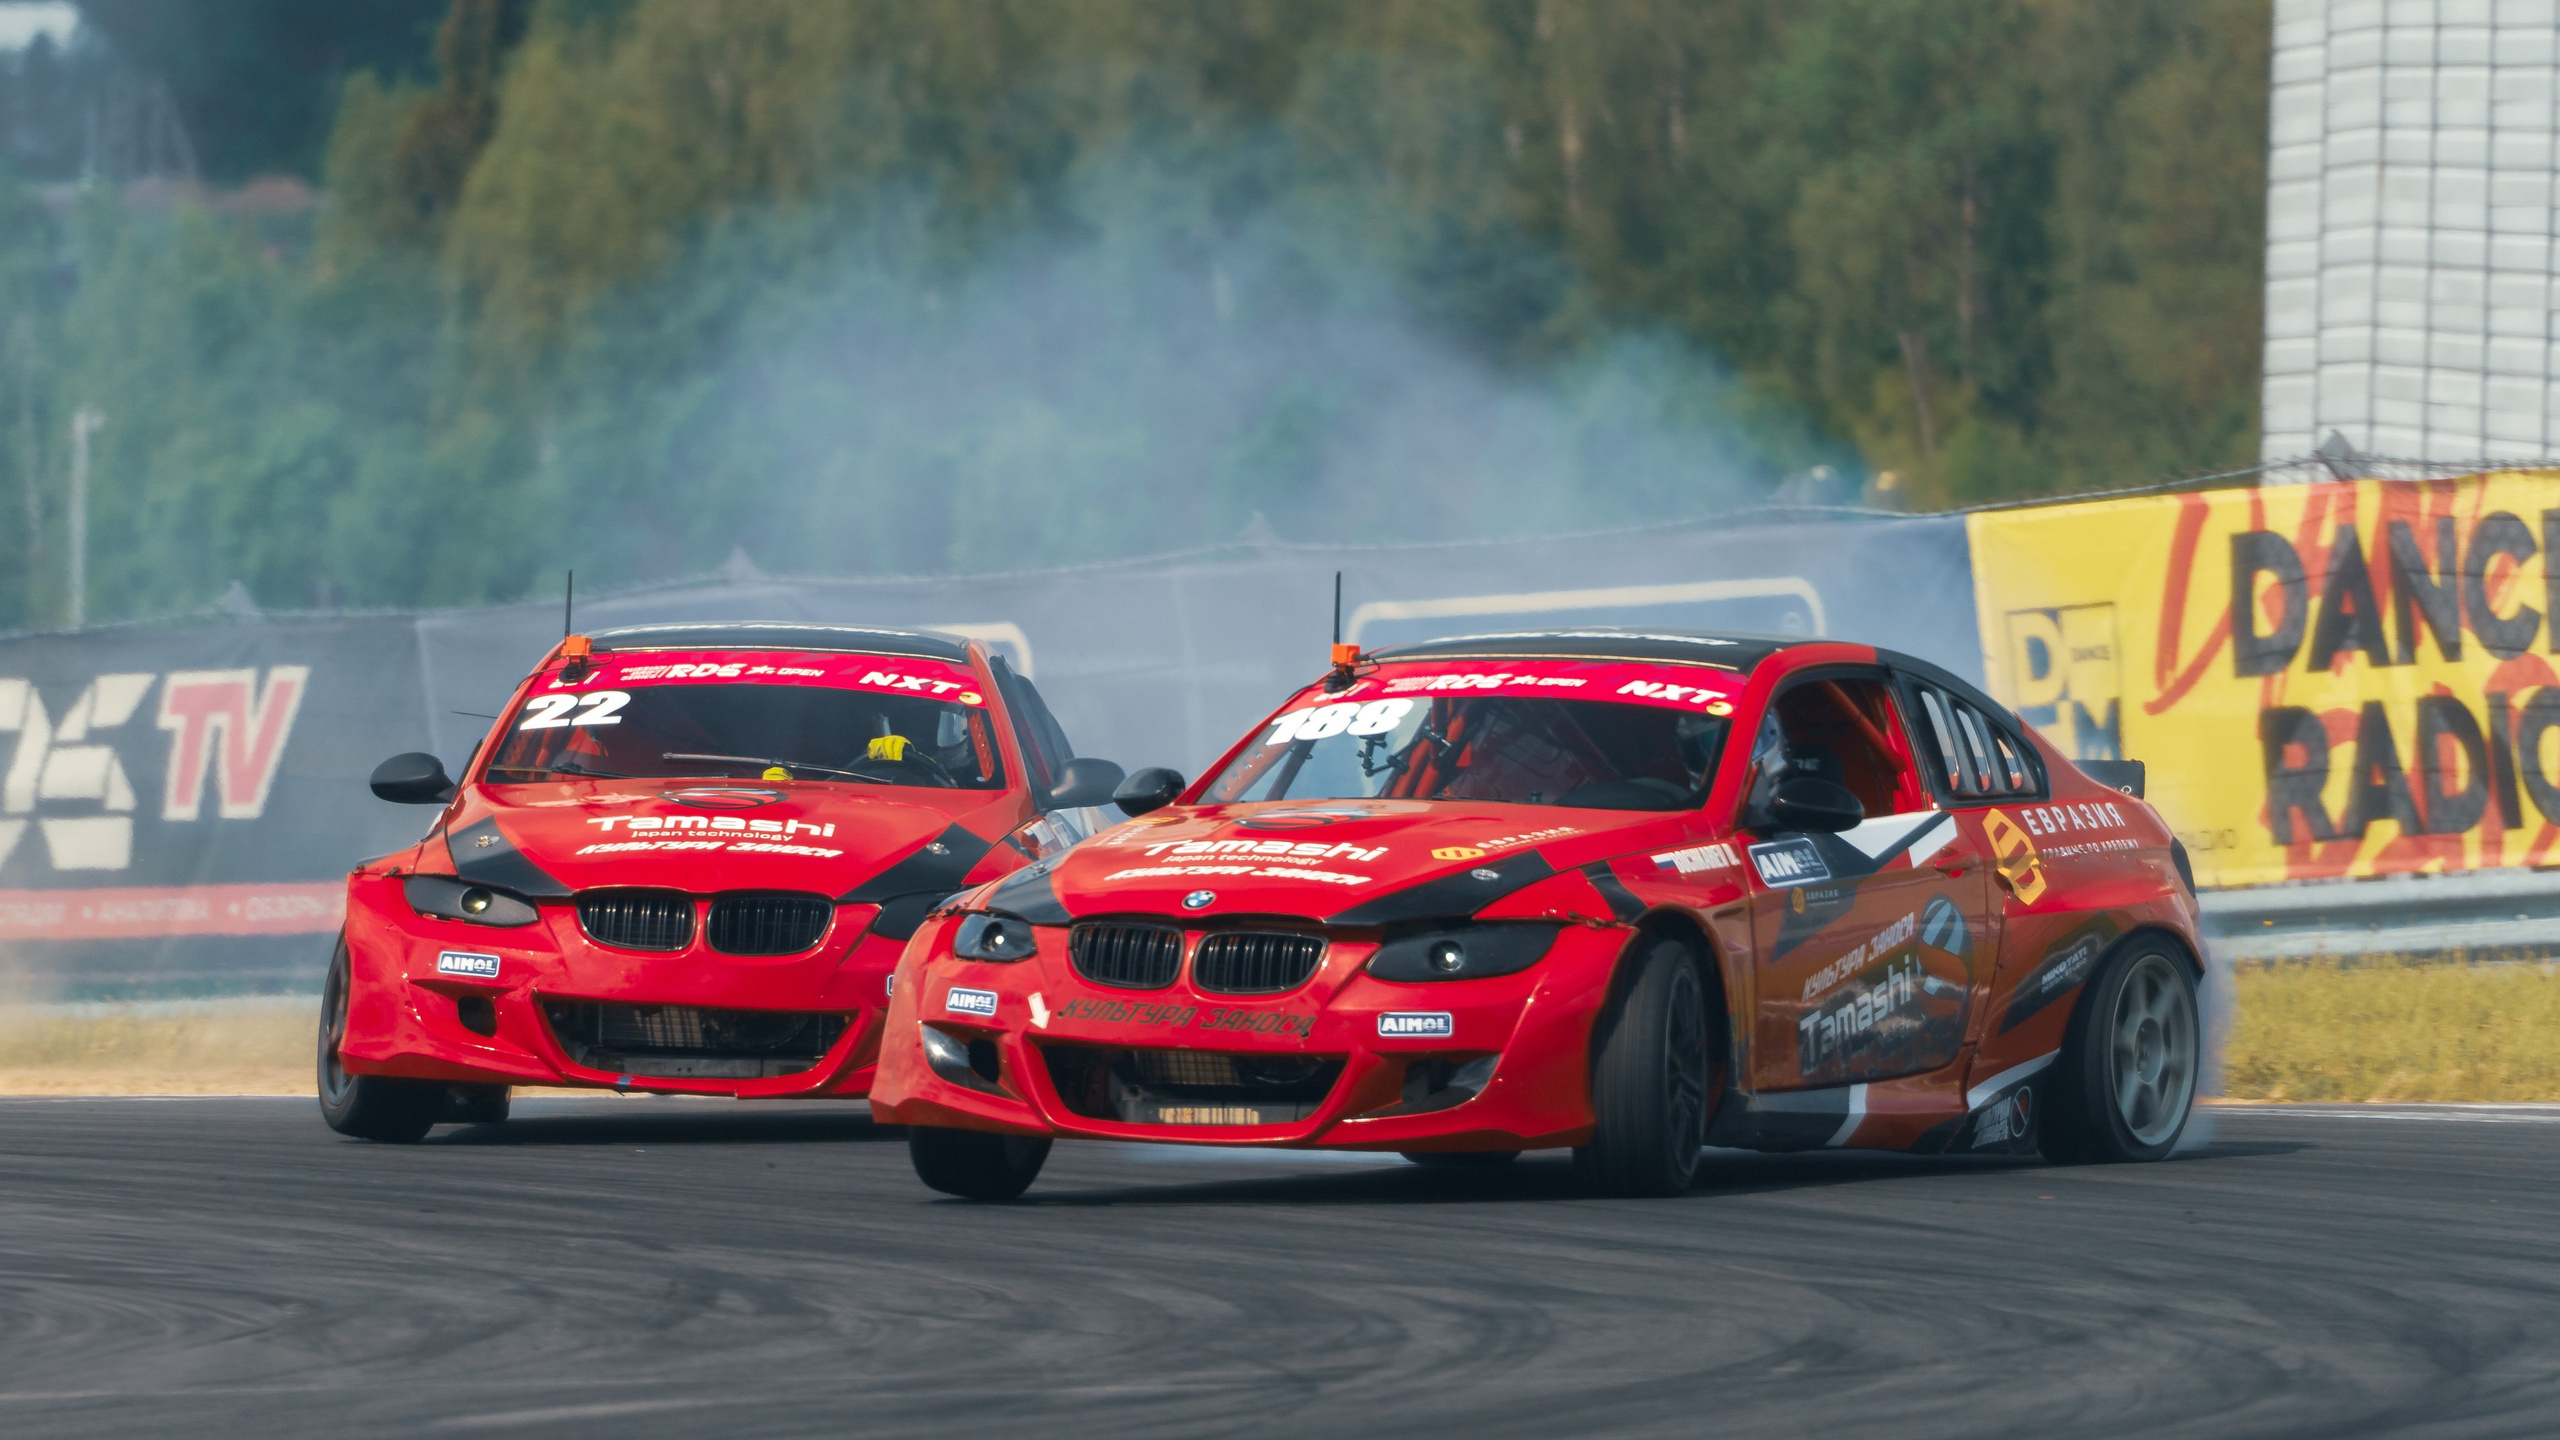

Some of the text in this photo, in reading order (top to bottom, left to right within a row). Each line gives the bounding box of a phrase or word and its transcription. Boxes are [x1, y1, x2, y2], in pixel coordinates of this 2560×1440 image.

[666, 663, 825, 679] RDS OPEN
[858, 671, 962, 694] NXT
[1426, 673, 1513, 690] RDS
[1616, 680, 1728, 704] NXT
[520, 690, 631, 731] 22
[1265, 698, 1414, 746] 188
[587, 815, 835, 838] Tamashi
[2021, 802, 2126, 836] ЕВРАЗИЯ
[631, 830, 794, 842] japan technology
[1144, 839, 1390, 862] Tamashi
[1162, 854, 1324, 866] japan technology
[1757, 847, 1823, 880] AIMOL
[440, 955, 496, 973] AIMOL
[1802, 911, 1915, 1001] КУЛЬТУРА ЗАНОСА
[948, 992, 993, 1009] AIMOL
[1799, 953, 1912, 1066] Tamashi
[1062, 998, 1317, 1038] КУЛЬТУРА ЗАНОСА
[1381, 1017, 1449, 1033] AIMOL
